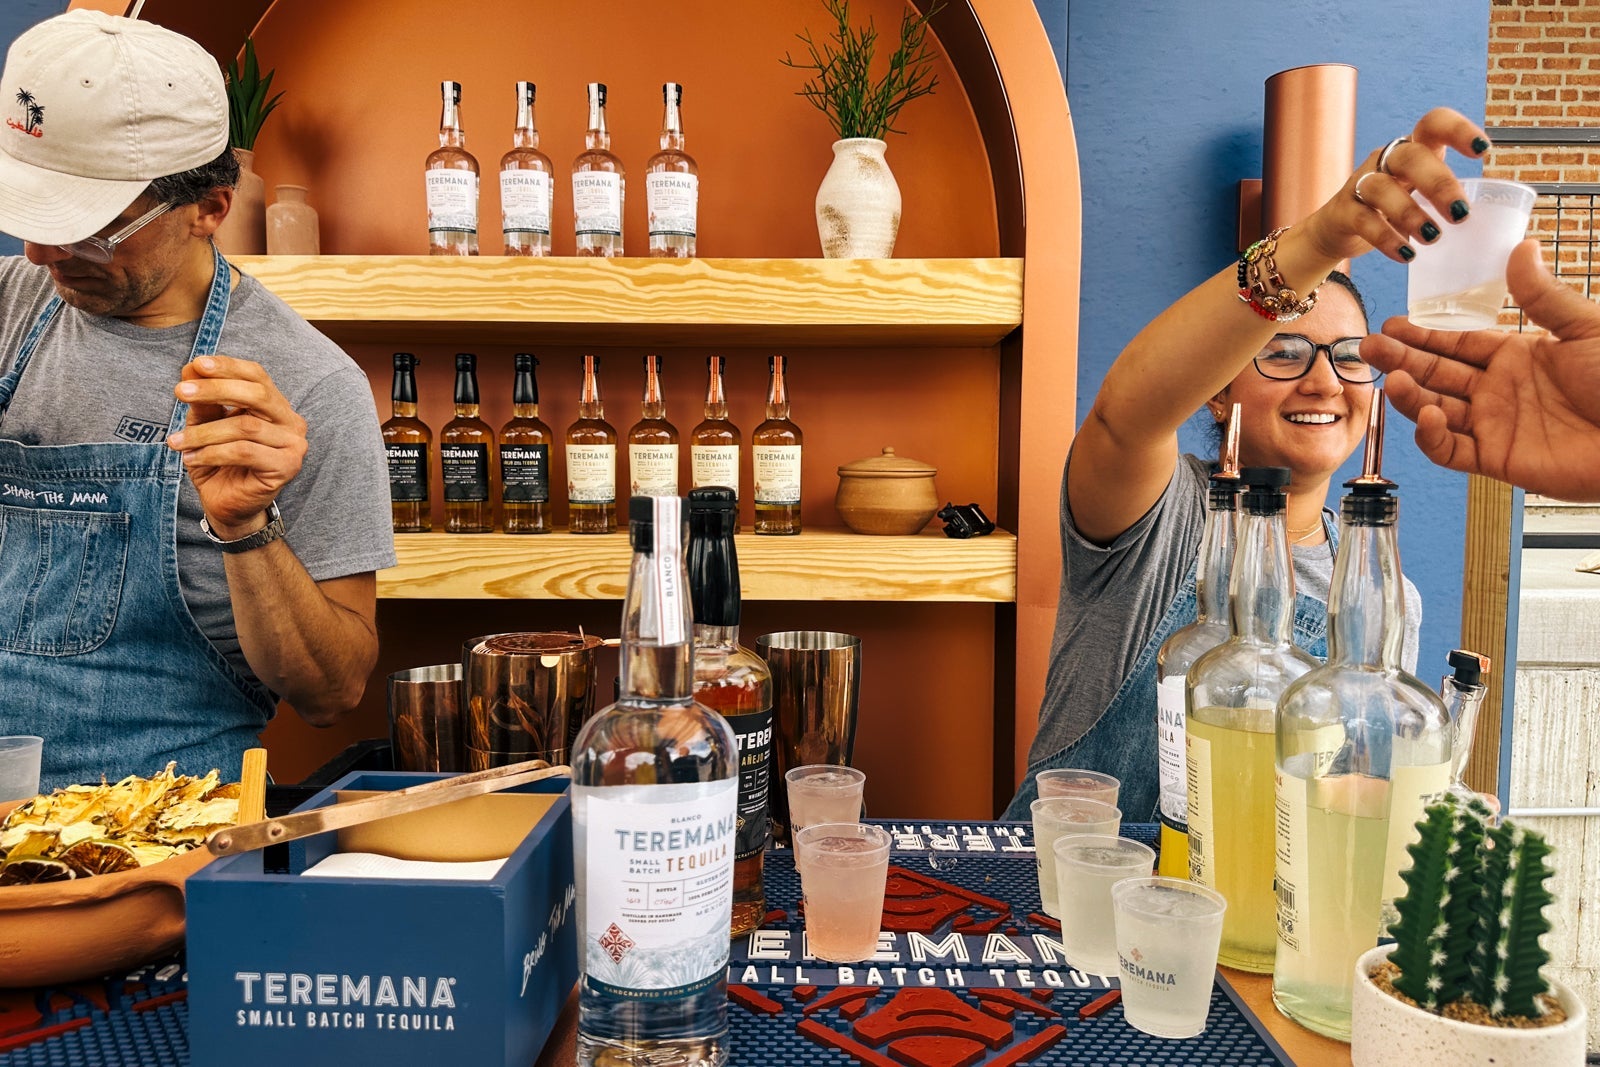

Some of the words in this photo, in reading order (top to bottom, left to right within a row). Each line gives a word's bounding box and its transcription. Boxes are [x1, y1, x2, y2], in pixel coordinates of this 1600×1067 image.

[428, 177, 468, 185] TEREMANA
[502, 178, 541, 186] TEREMANA
[574, 179, 612, 187] TEREMANA
[651, 180, 691, 189] TEREMANA
[386, 450, 419, 458] REMANA
[441, 450, 479, 458] TEREMANA
[501, 451, 541, 459] TEREMANA
[569, 452, 609, 460] TEREMANA
[634, 452, 674, 460] TEREMANA
[3, 484, 36, 500] SHARE
[36, 491, 65, 504] THE
[70, 492, 108, 506] MANA
[664, 556, 675, 597] BLANCO
[741, 753, 764, 767] AÑEJO
[671, 814, 702, 824] BLANCO
[615, 813, 734, 852] TEREMANA
[666, 843, 727, 872] TEQUILA
[629, 867, 660, 875] BATCH
[727, 965, 810, 984] ALL
[838, 966, 965, 987] BATCH
[989, 968, 1111, 988] TEQUI
[235, 972, 456, 1008] TEREMANA
[603, 986, 660, 997] HANDCRAFTED
[236, 1009, 297, 1027] SMALL
[306, 1011, 366, 1028] BATCH
[376, 1012, 455, 1031] TEQUILA
